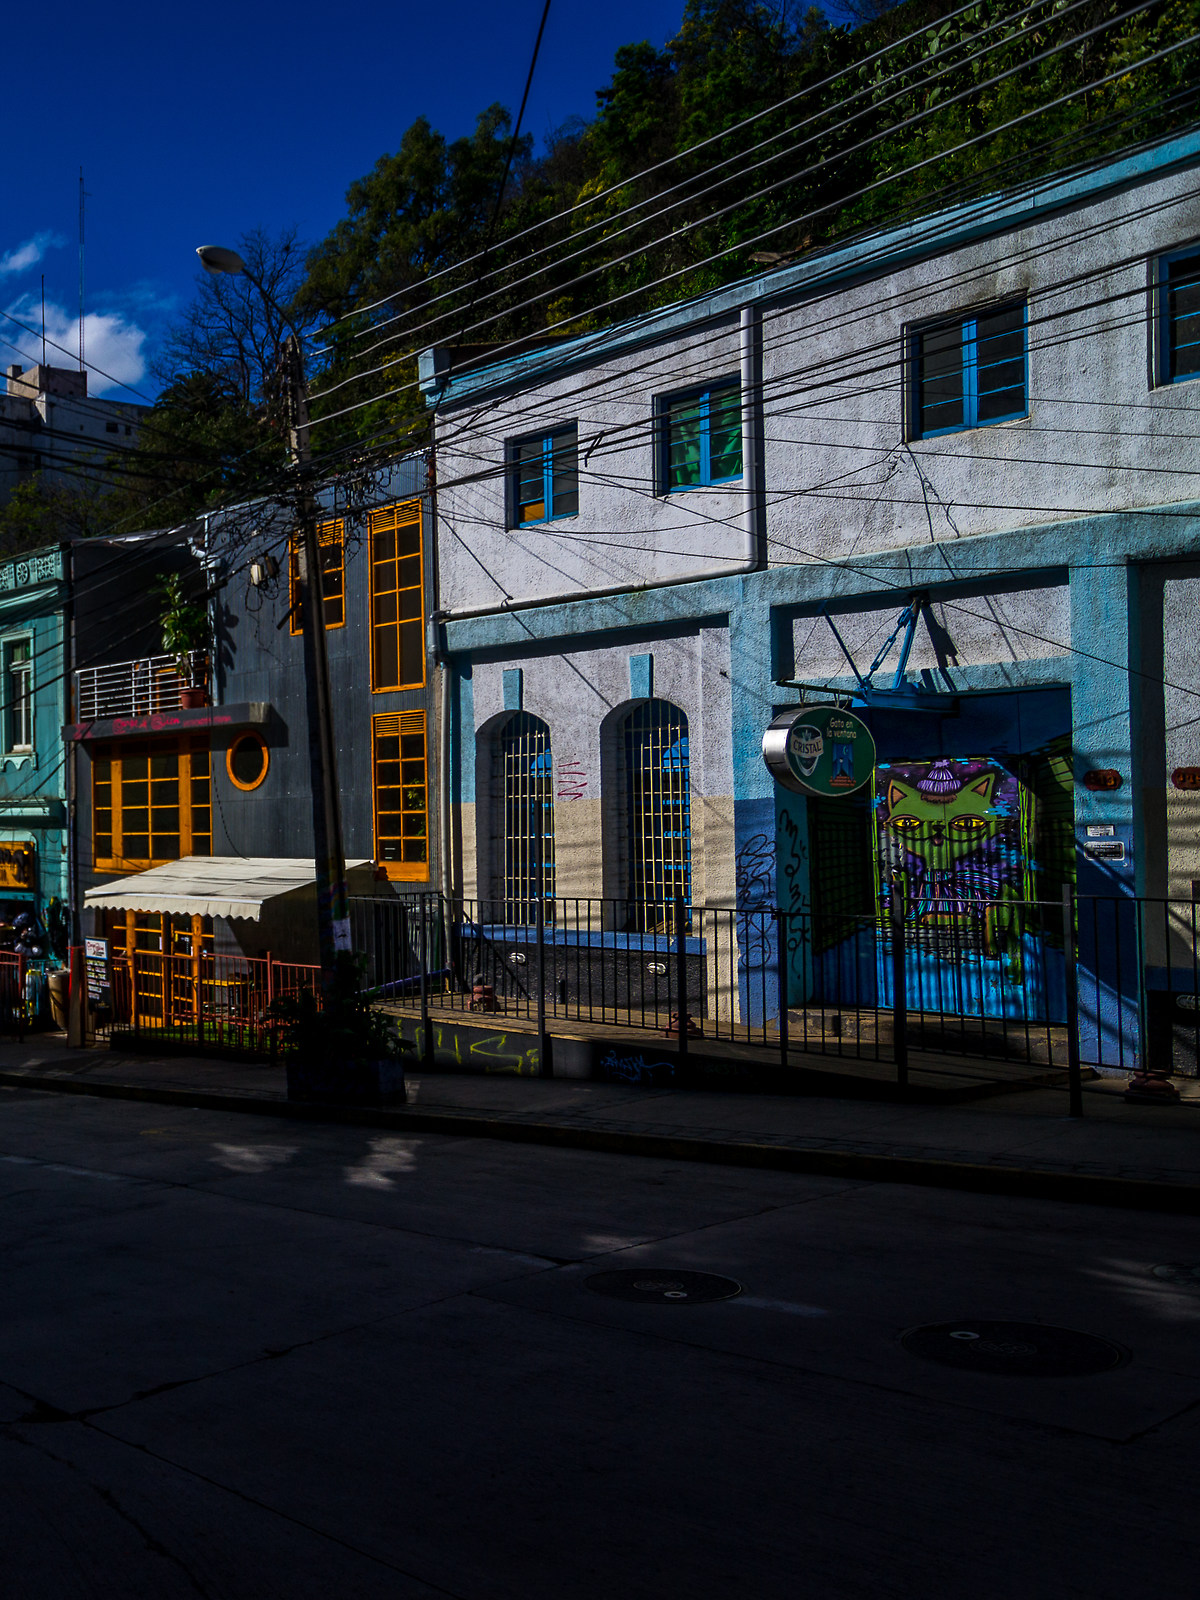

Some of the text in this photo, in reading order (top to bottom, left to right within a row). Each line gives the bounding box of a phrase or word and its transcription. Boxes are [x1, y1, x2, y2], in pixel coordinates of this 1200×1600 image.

[829, 717, 854, 729] Gato en
[826, 727, 857, 738] la ventana
[793, 739, 822, 753] CRISTAL
